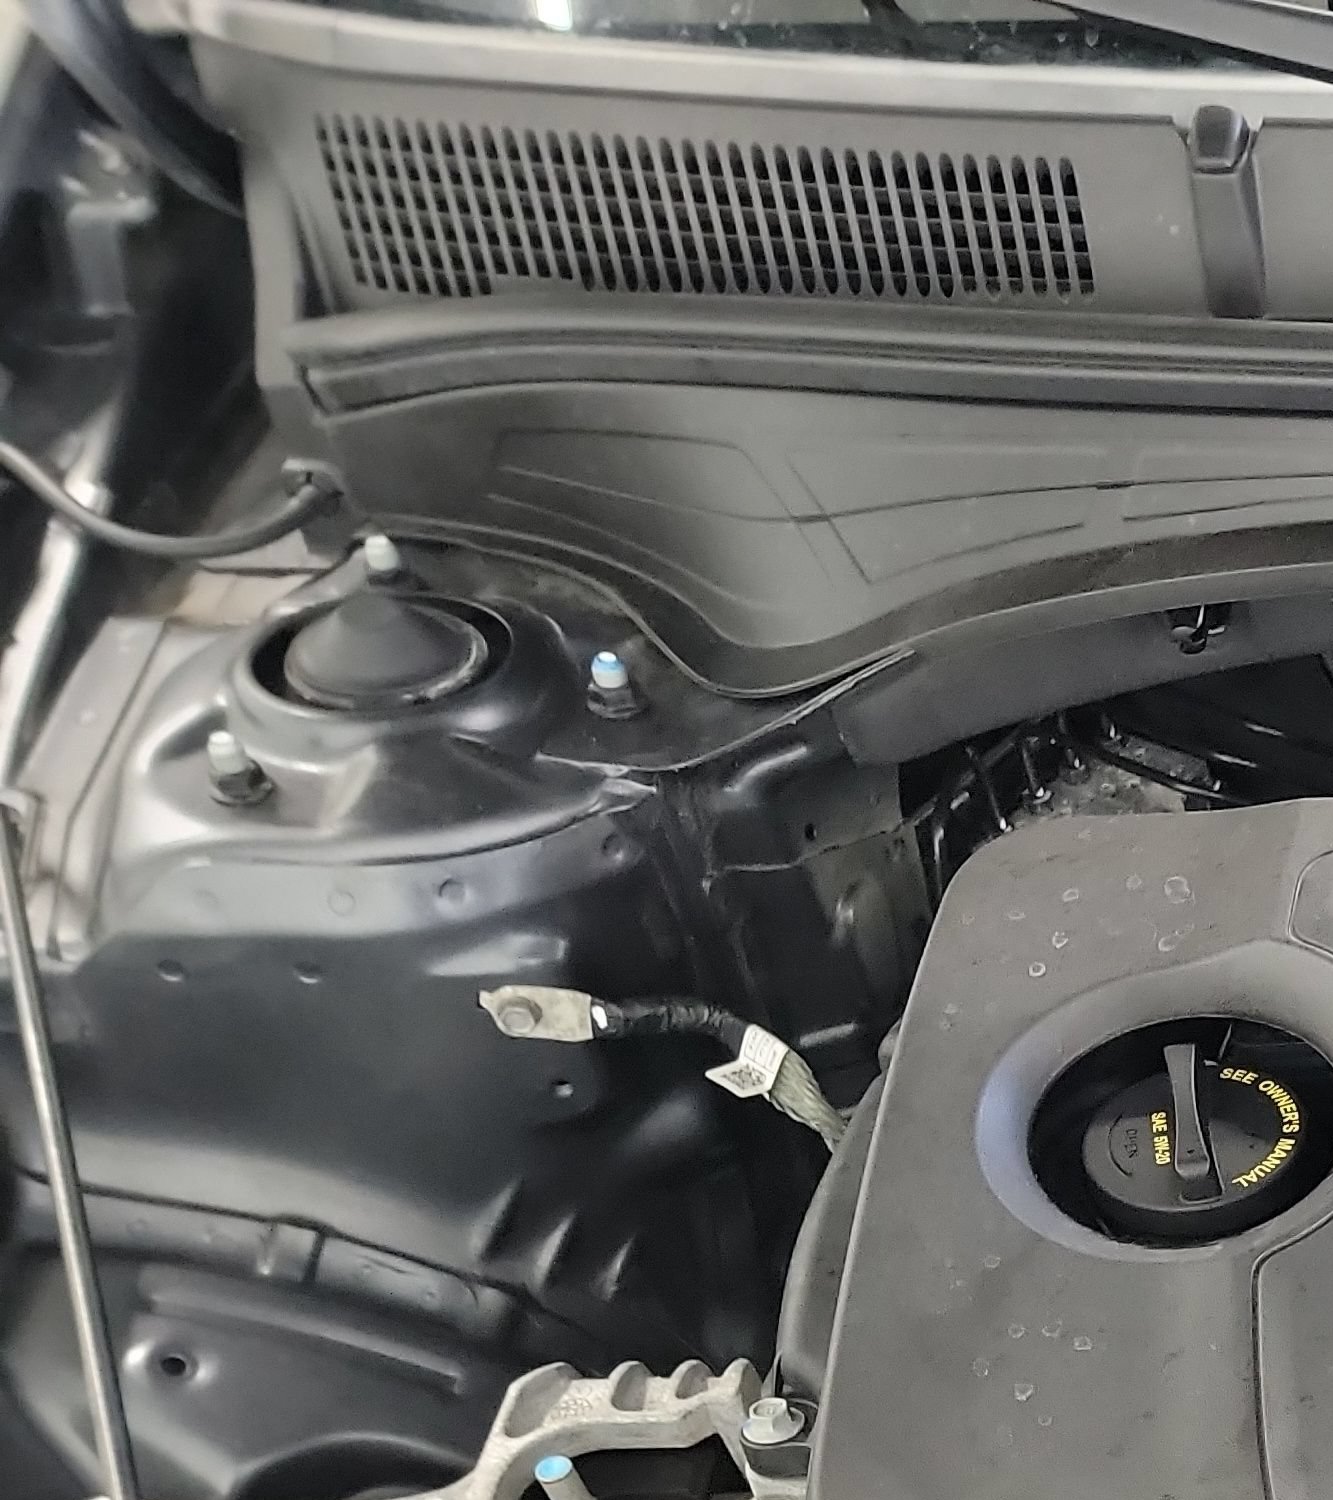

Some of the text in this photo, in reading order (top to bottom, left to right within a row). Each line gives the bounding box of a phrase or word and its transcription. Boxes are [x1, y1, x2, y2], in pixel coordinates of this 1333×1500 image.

[1151, 1111, 1170, 1165] SAE 5W-20
[1220, 1067, 1300, 1188] SEE OWNER'S MANUAL
